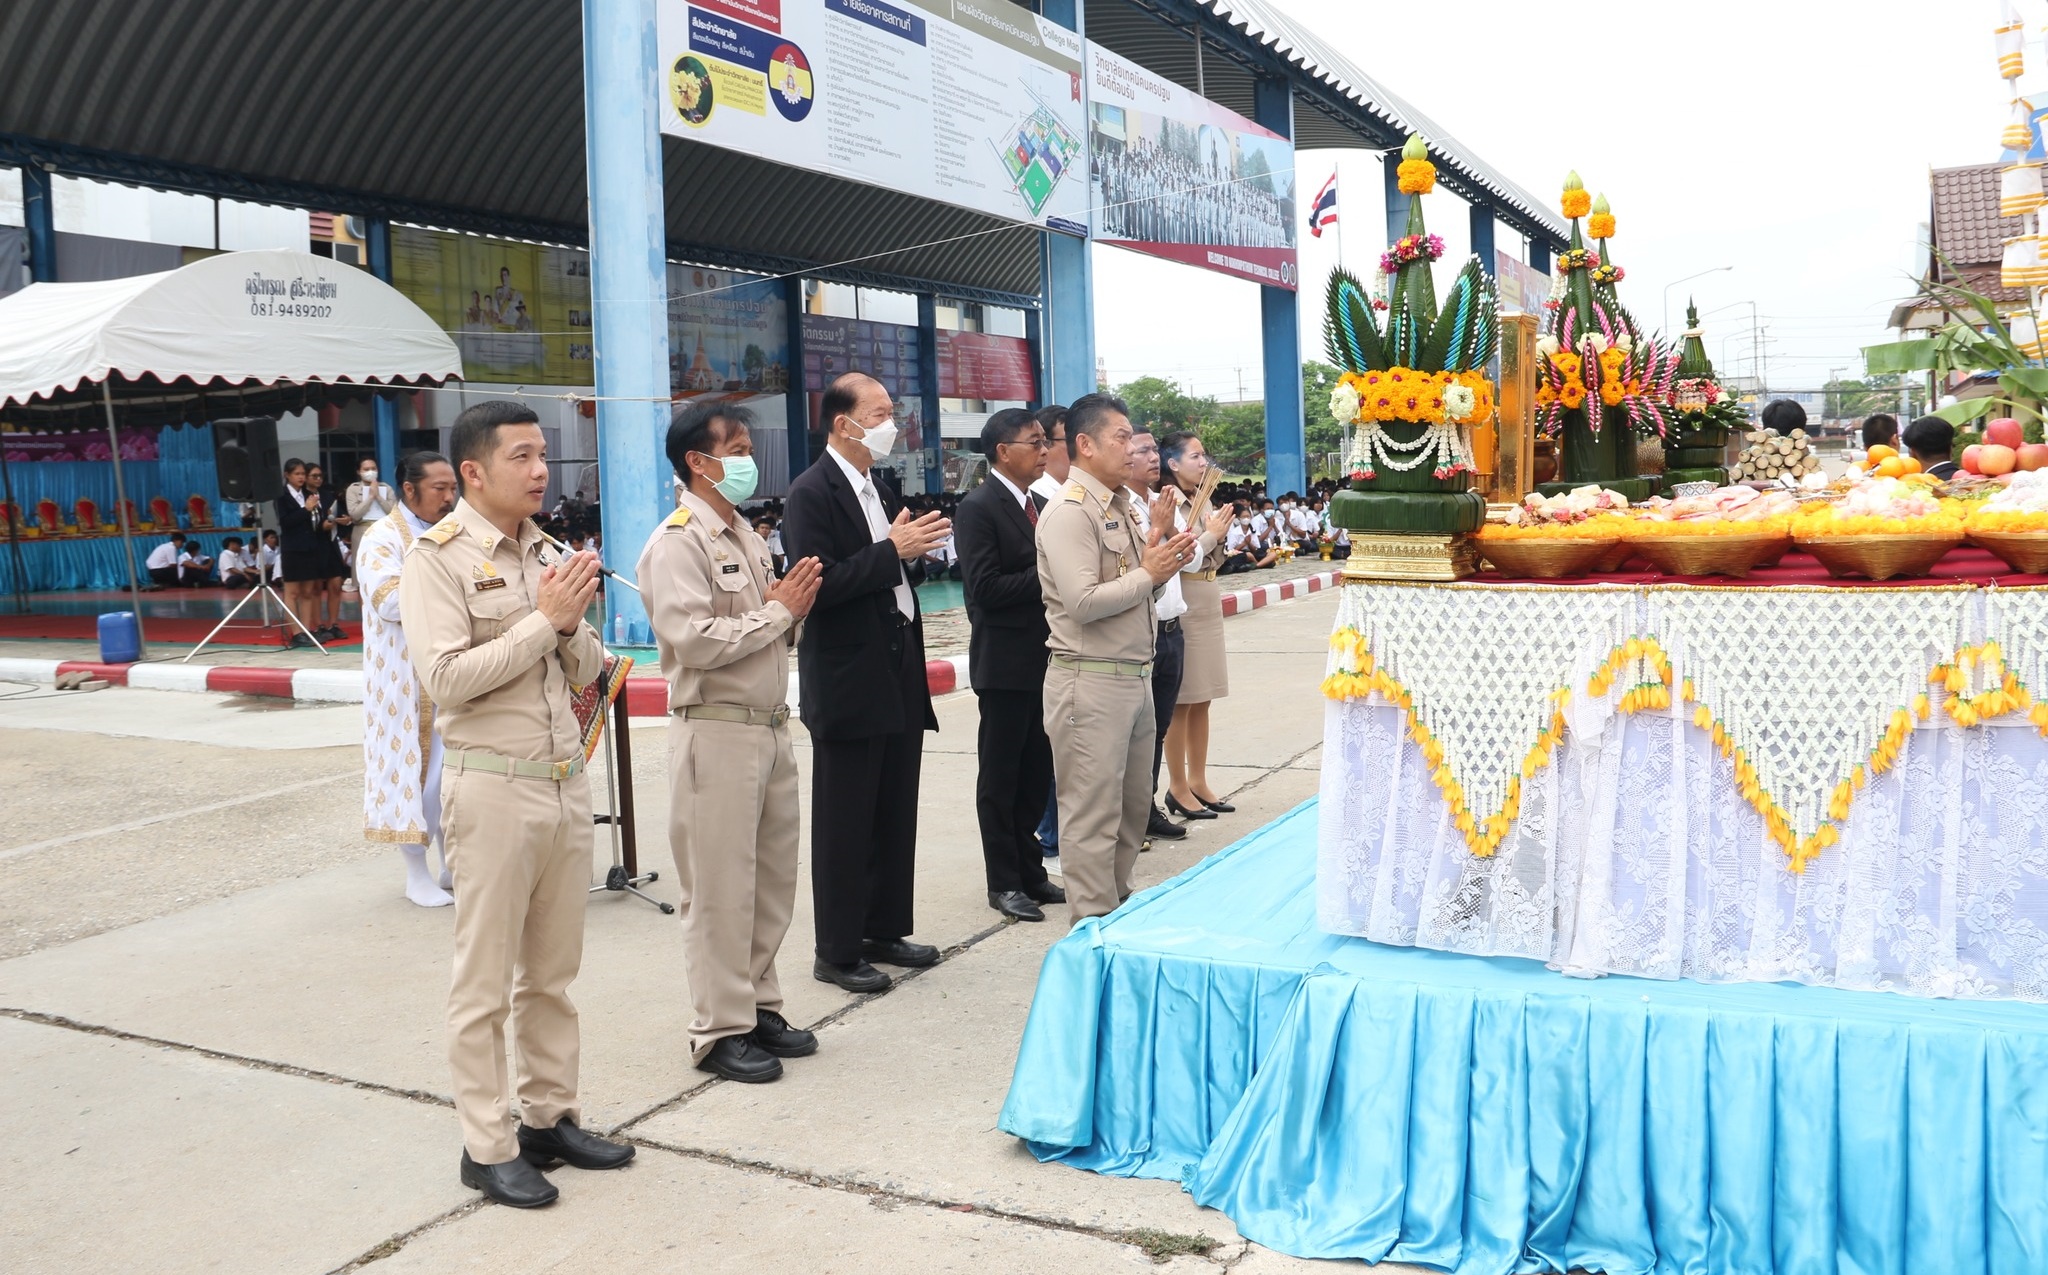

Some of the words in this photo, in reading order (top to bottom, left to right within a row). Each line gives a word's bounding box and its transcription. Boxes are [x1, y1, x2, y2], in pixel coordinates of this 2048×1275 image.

[1042, 26, 1065, 47] College
[1066, 37, 1080, 54] Map
[1095, 52, 1171, 102] วิทยาลัยเทคนิคนครปฐม
[1096, 70, 1135, 100] ยินดีต้อนรับ
[251, 303, 332, 317] 081-9489202
